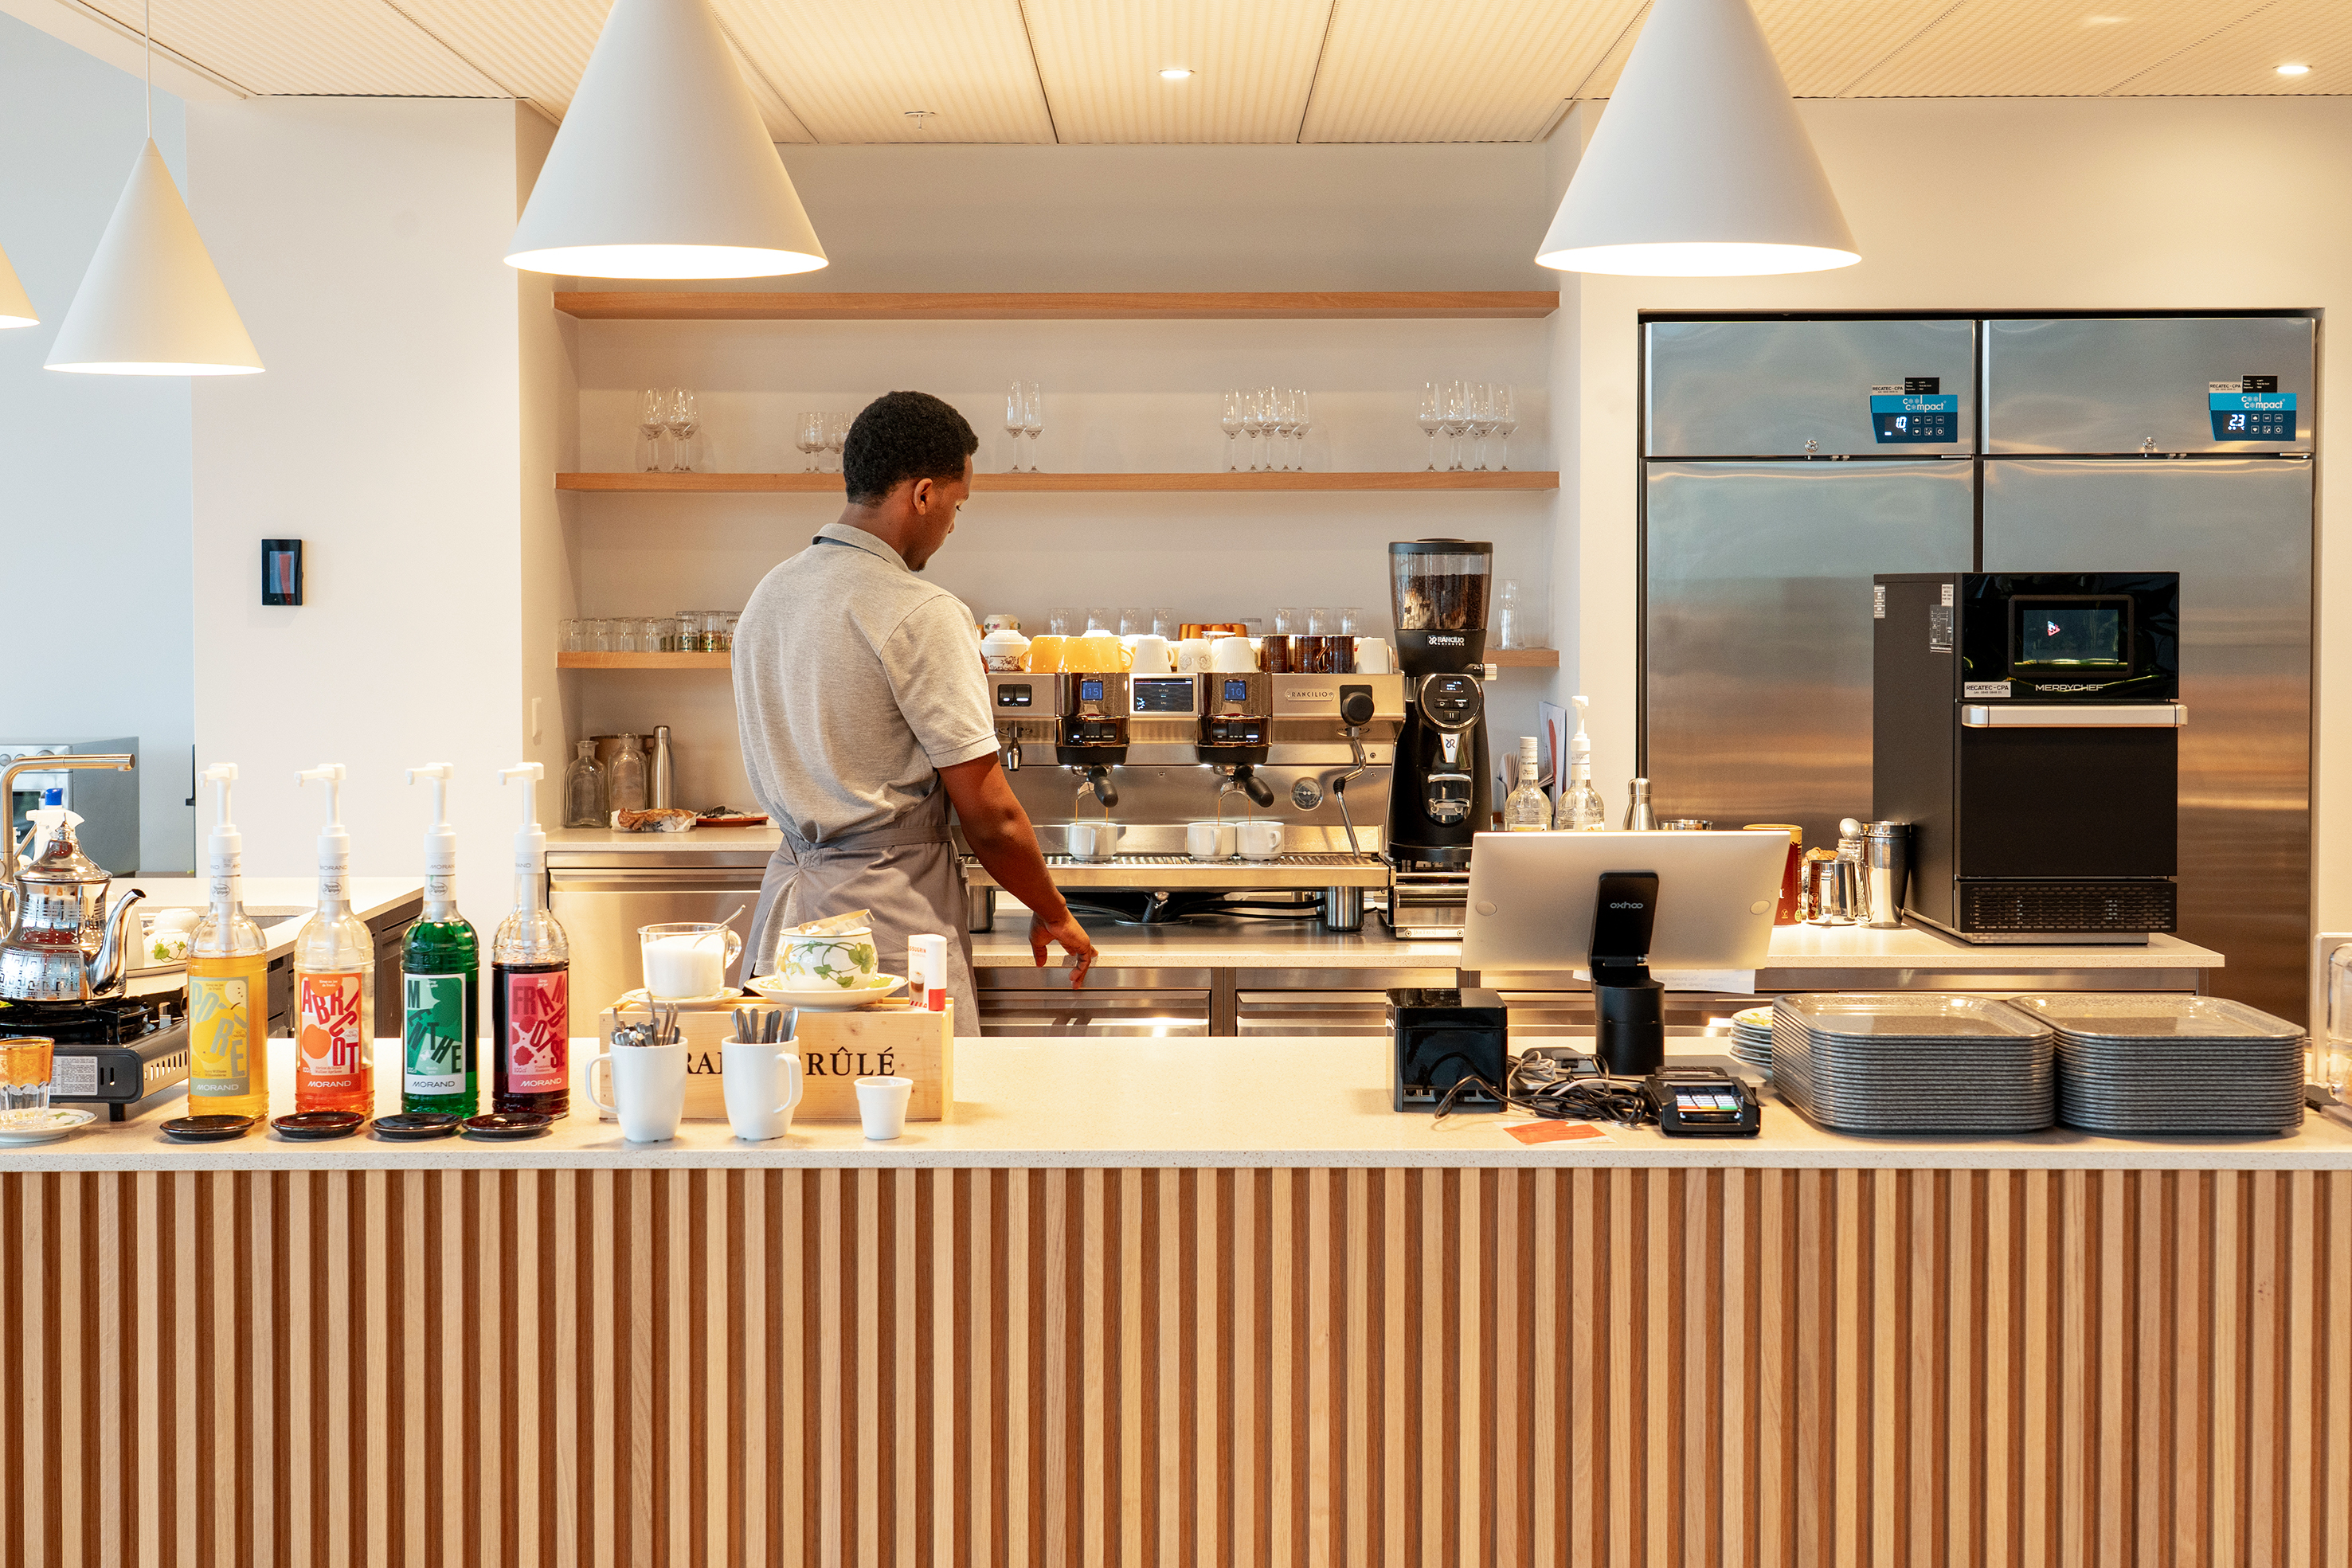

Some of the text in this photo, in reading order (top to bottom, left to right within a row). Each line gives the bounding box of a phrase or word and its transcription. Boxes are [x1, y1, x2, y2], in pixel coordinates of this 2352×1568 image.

[1087, 687, 1099, 696] 15
[1231, 687, 1243, 696] 10
[908, 945, 926, 954] SSUGRIN
[407, 980, 461, 1073] MENTHE
[799, 1046, 895, 1076] RÛLÉ
[520, 1077, 562, 1087] MORAND
